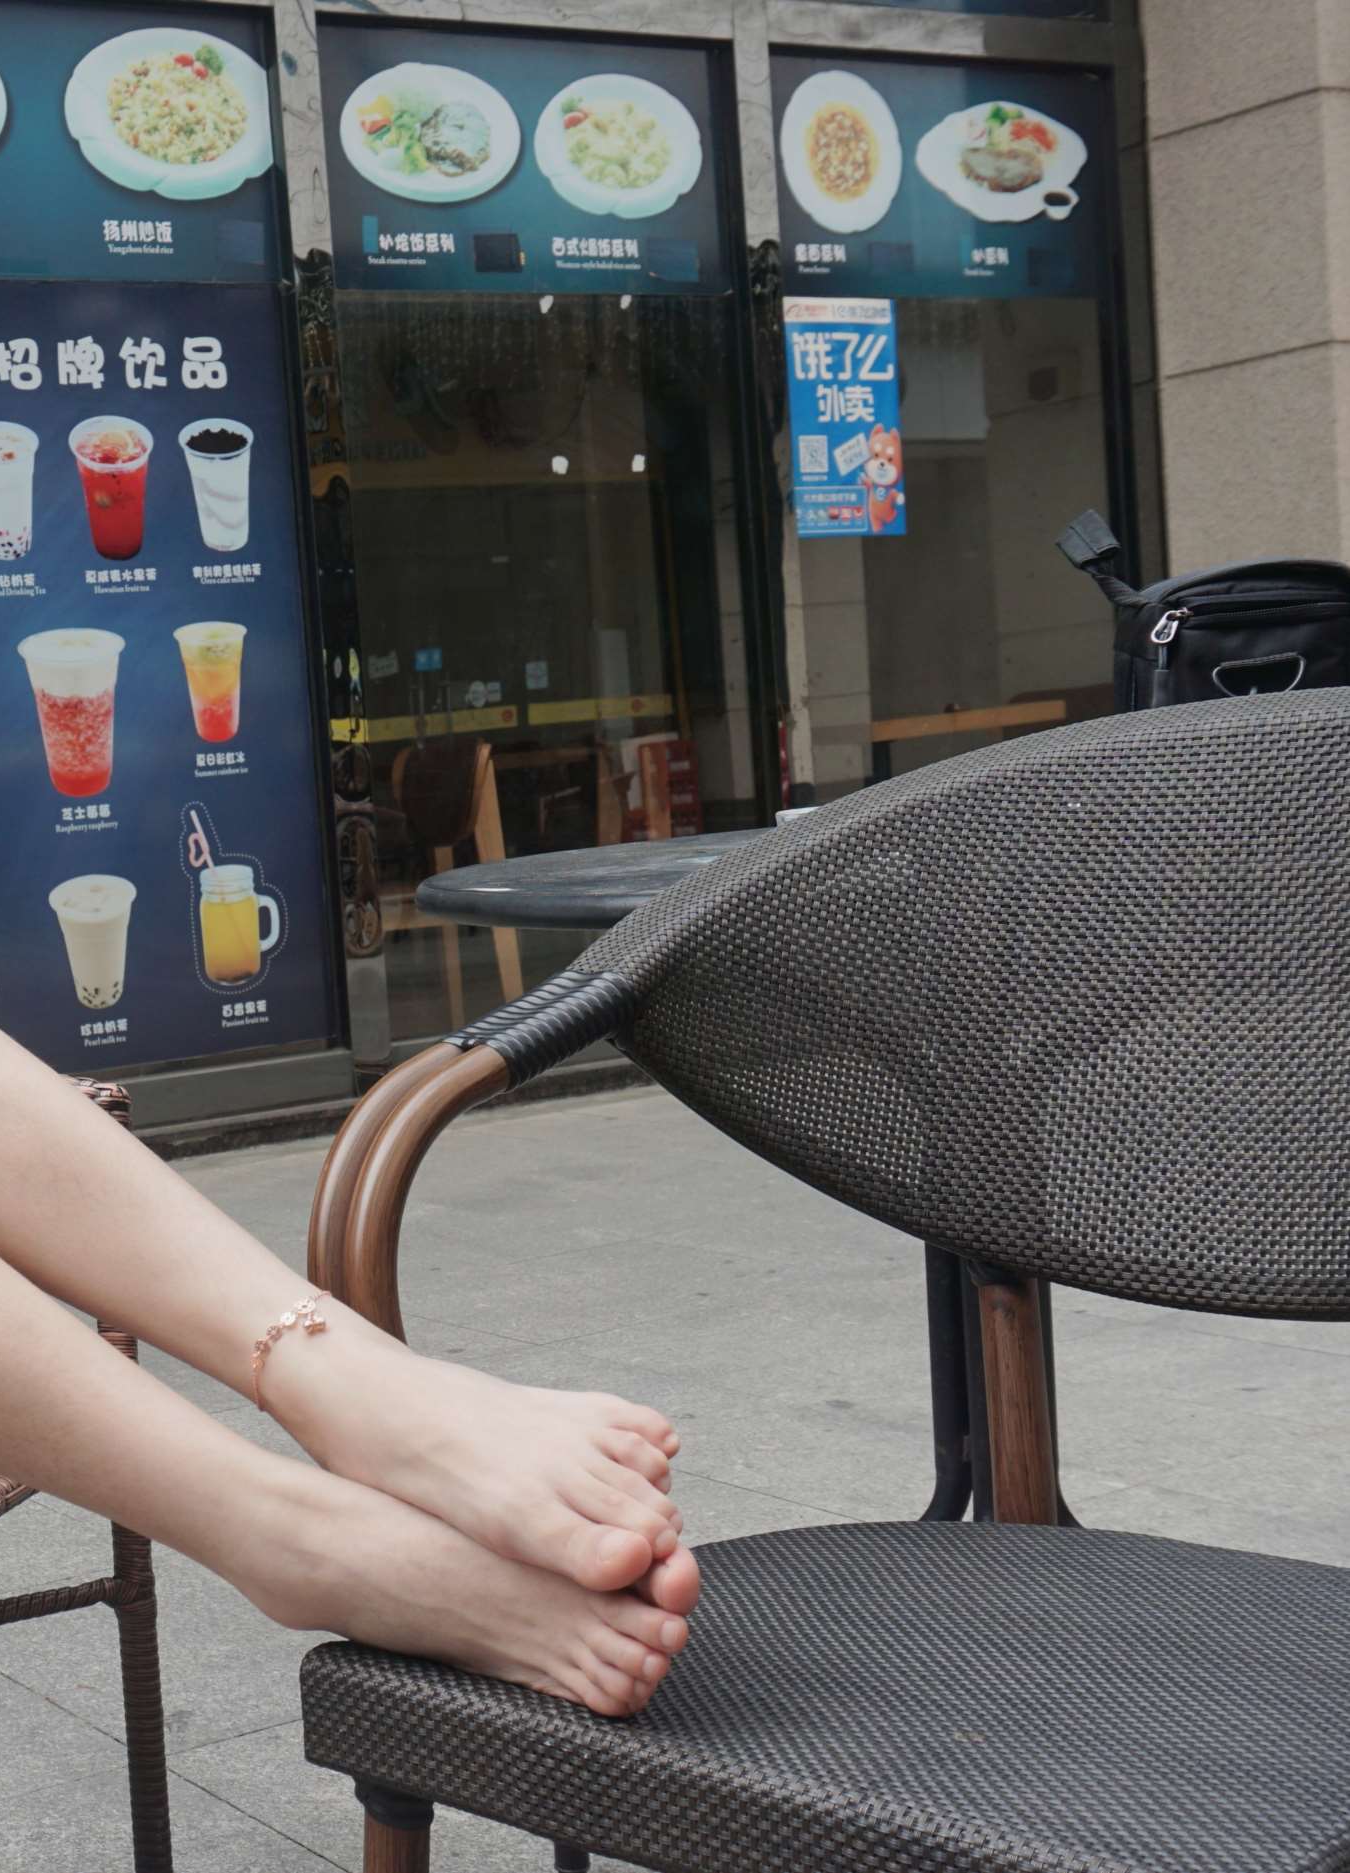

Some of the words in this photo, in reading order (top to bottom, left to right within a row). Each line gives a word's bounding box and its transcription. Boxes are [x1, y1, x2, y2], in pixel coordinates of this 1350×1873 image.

[102, 219, 173, 243] 扬州炒饭
[792, 331, 895, 381] 饿了么
[816, 383, 876, 423] 外卖
[54, 823, 87, 835] Raspberry
[88, 820, 119, 832] raspberry
[221, 999, 267, 1018] 百香果茶
[80, 1018, 128, 1037] 珍珠奶茶
